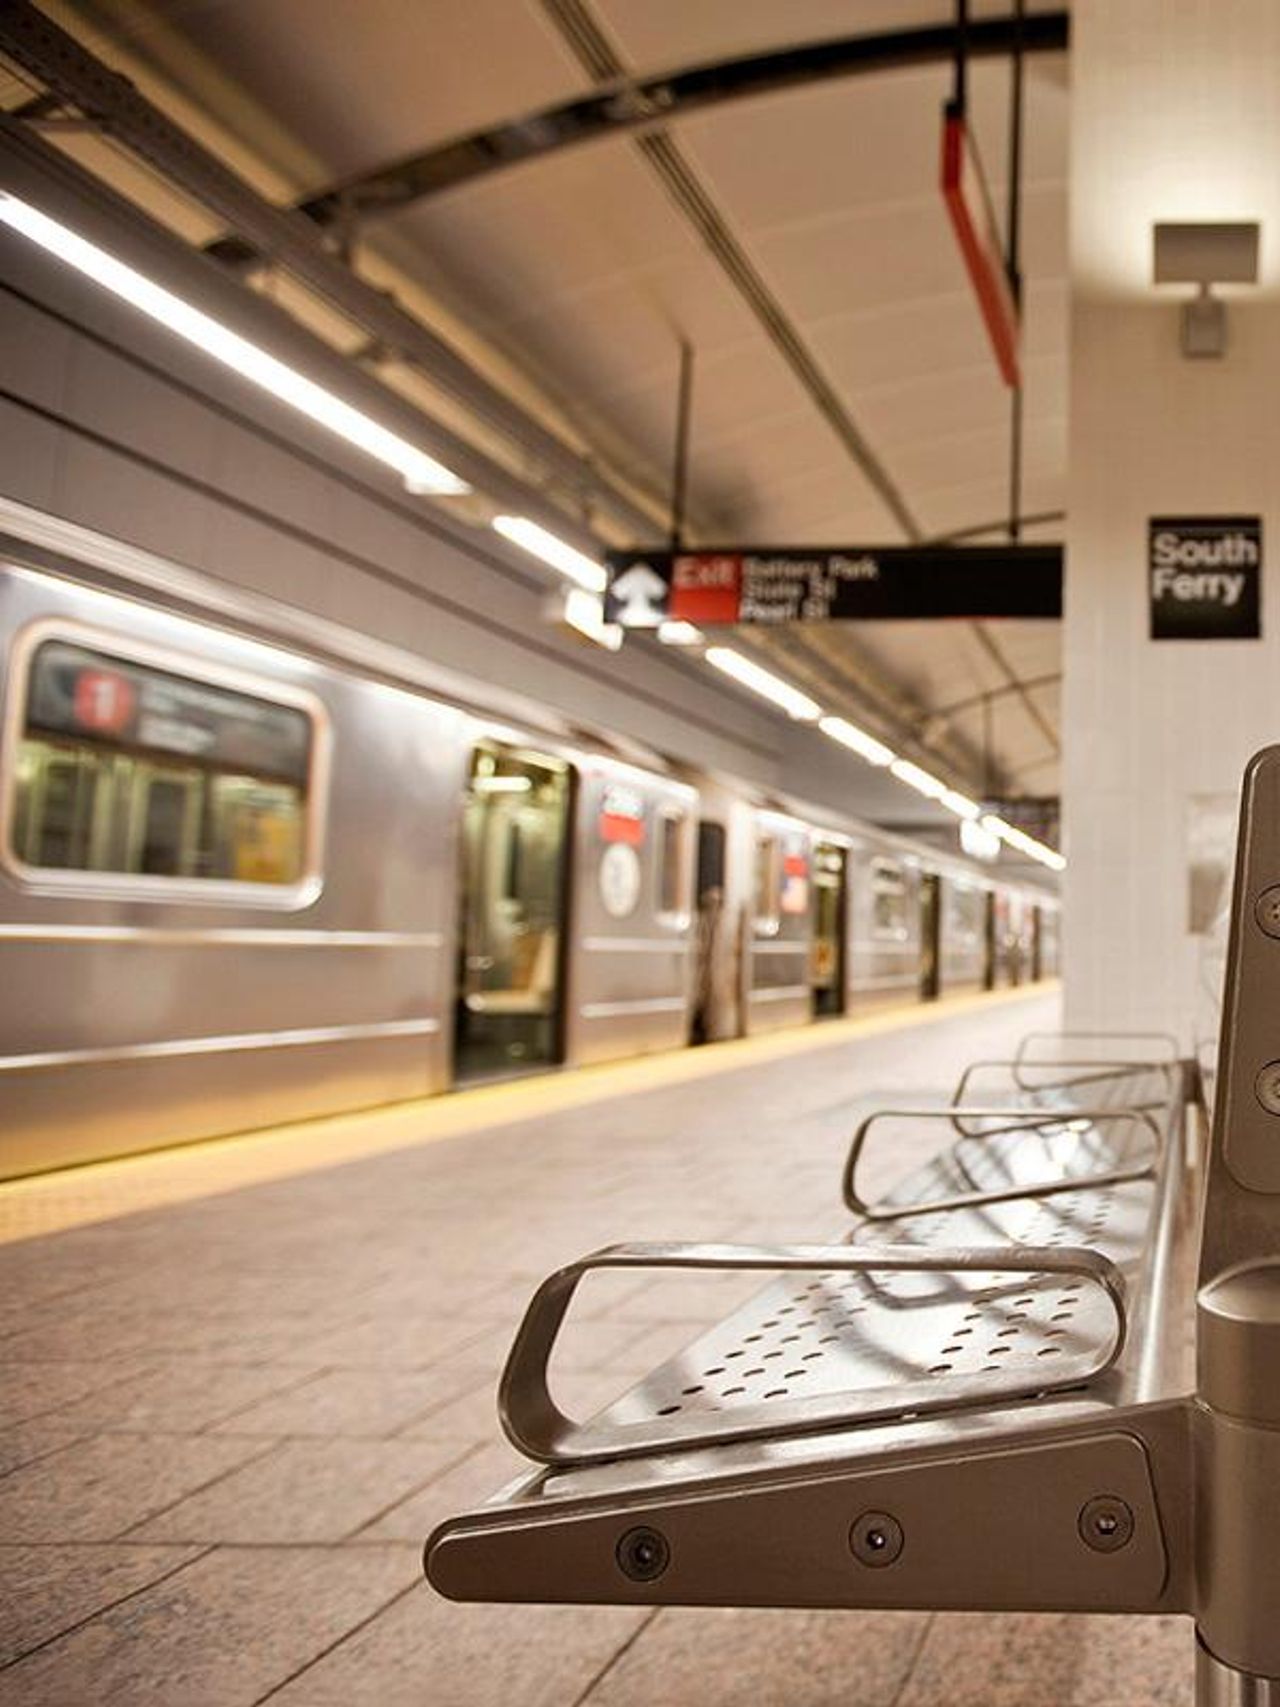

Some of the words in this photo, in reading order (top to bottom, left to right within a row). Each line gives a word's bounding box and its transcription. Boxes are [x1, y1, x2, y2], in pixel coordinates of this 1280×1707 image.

[1154, 532, 1257, 566] South
[673, 557, 736, 584] Exit
[829, 556, 879, 580] Park
[1152, 567, 1245, 606] Ferry
